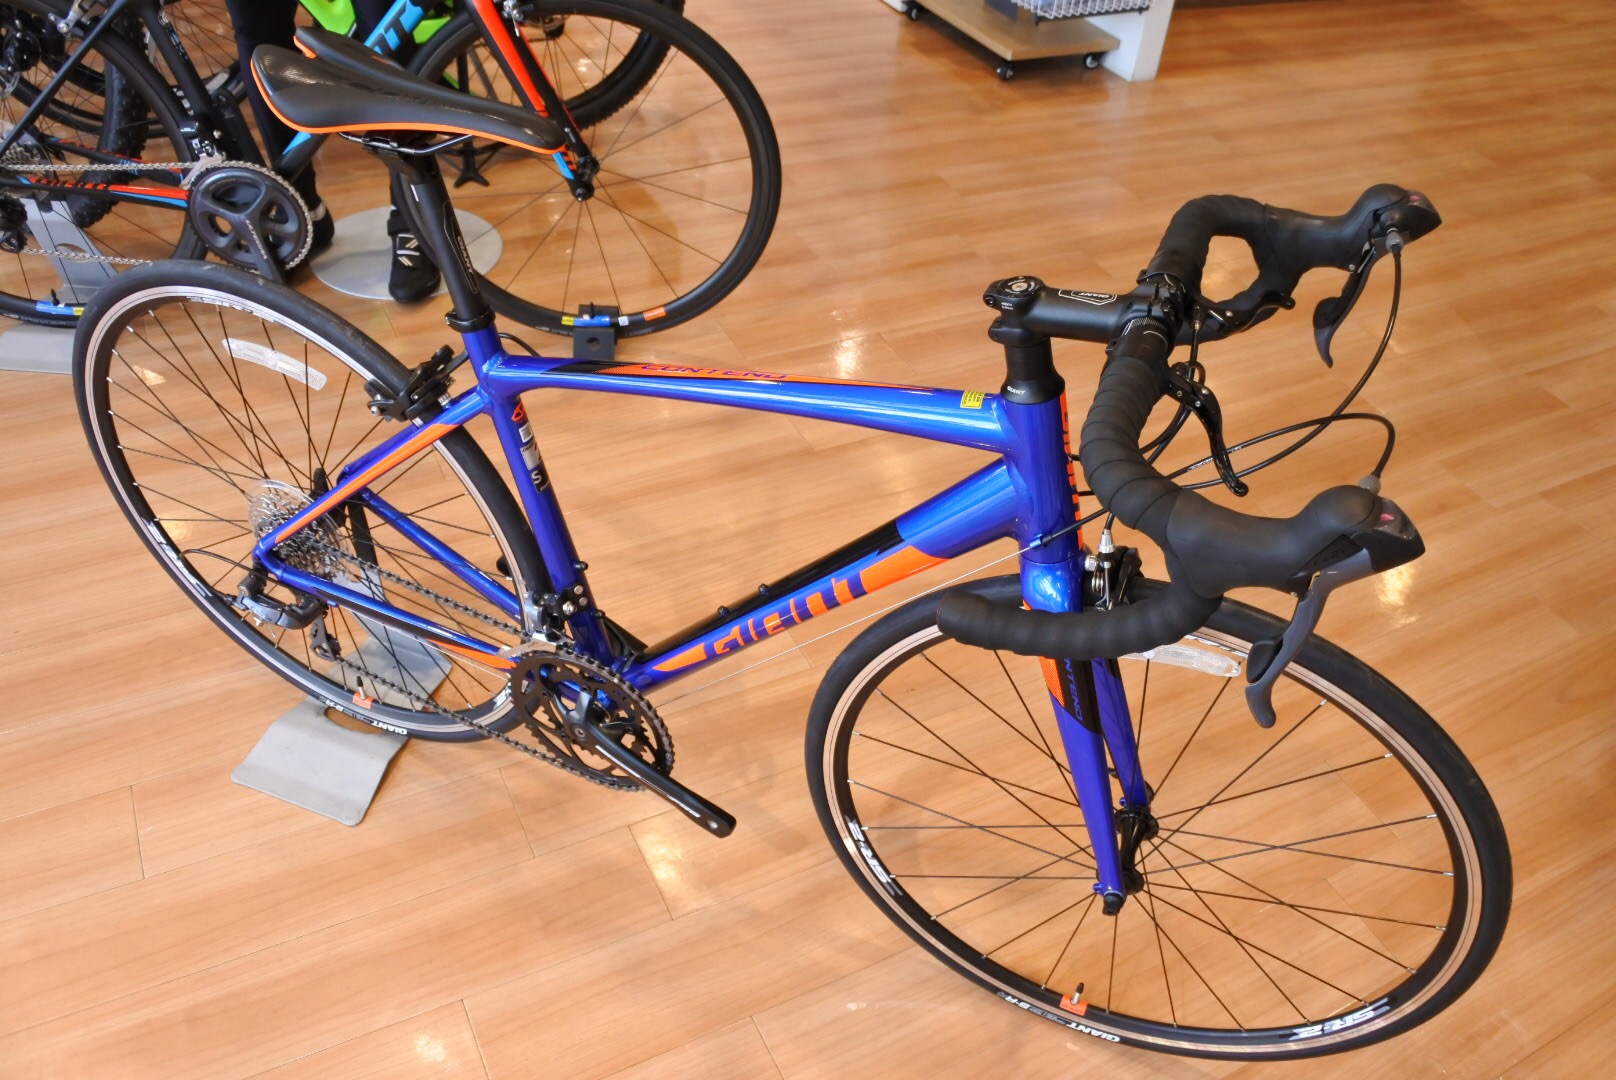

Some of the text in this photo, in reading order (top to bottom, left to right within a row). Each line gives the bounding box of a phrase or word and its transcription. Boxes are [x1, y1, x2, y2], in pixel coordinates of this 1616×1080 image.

[1006, 385, 1026, 396] GIANT
[1063, 657, 1083, 721] NTEND
[371, 720, 408, 736] GIANT
[1066, 1022, 1120, 1043] GIANT
